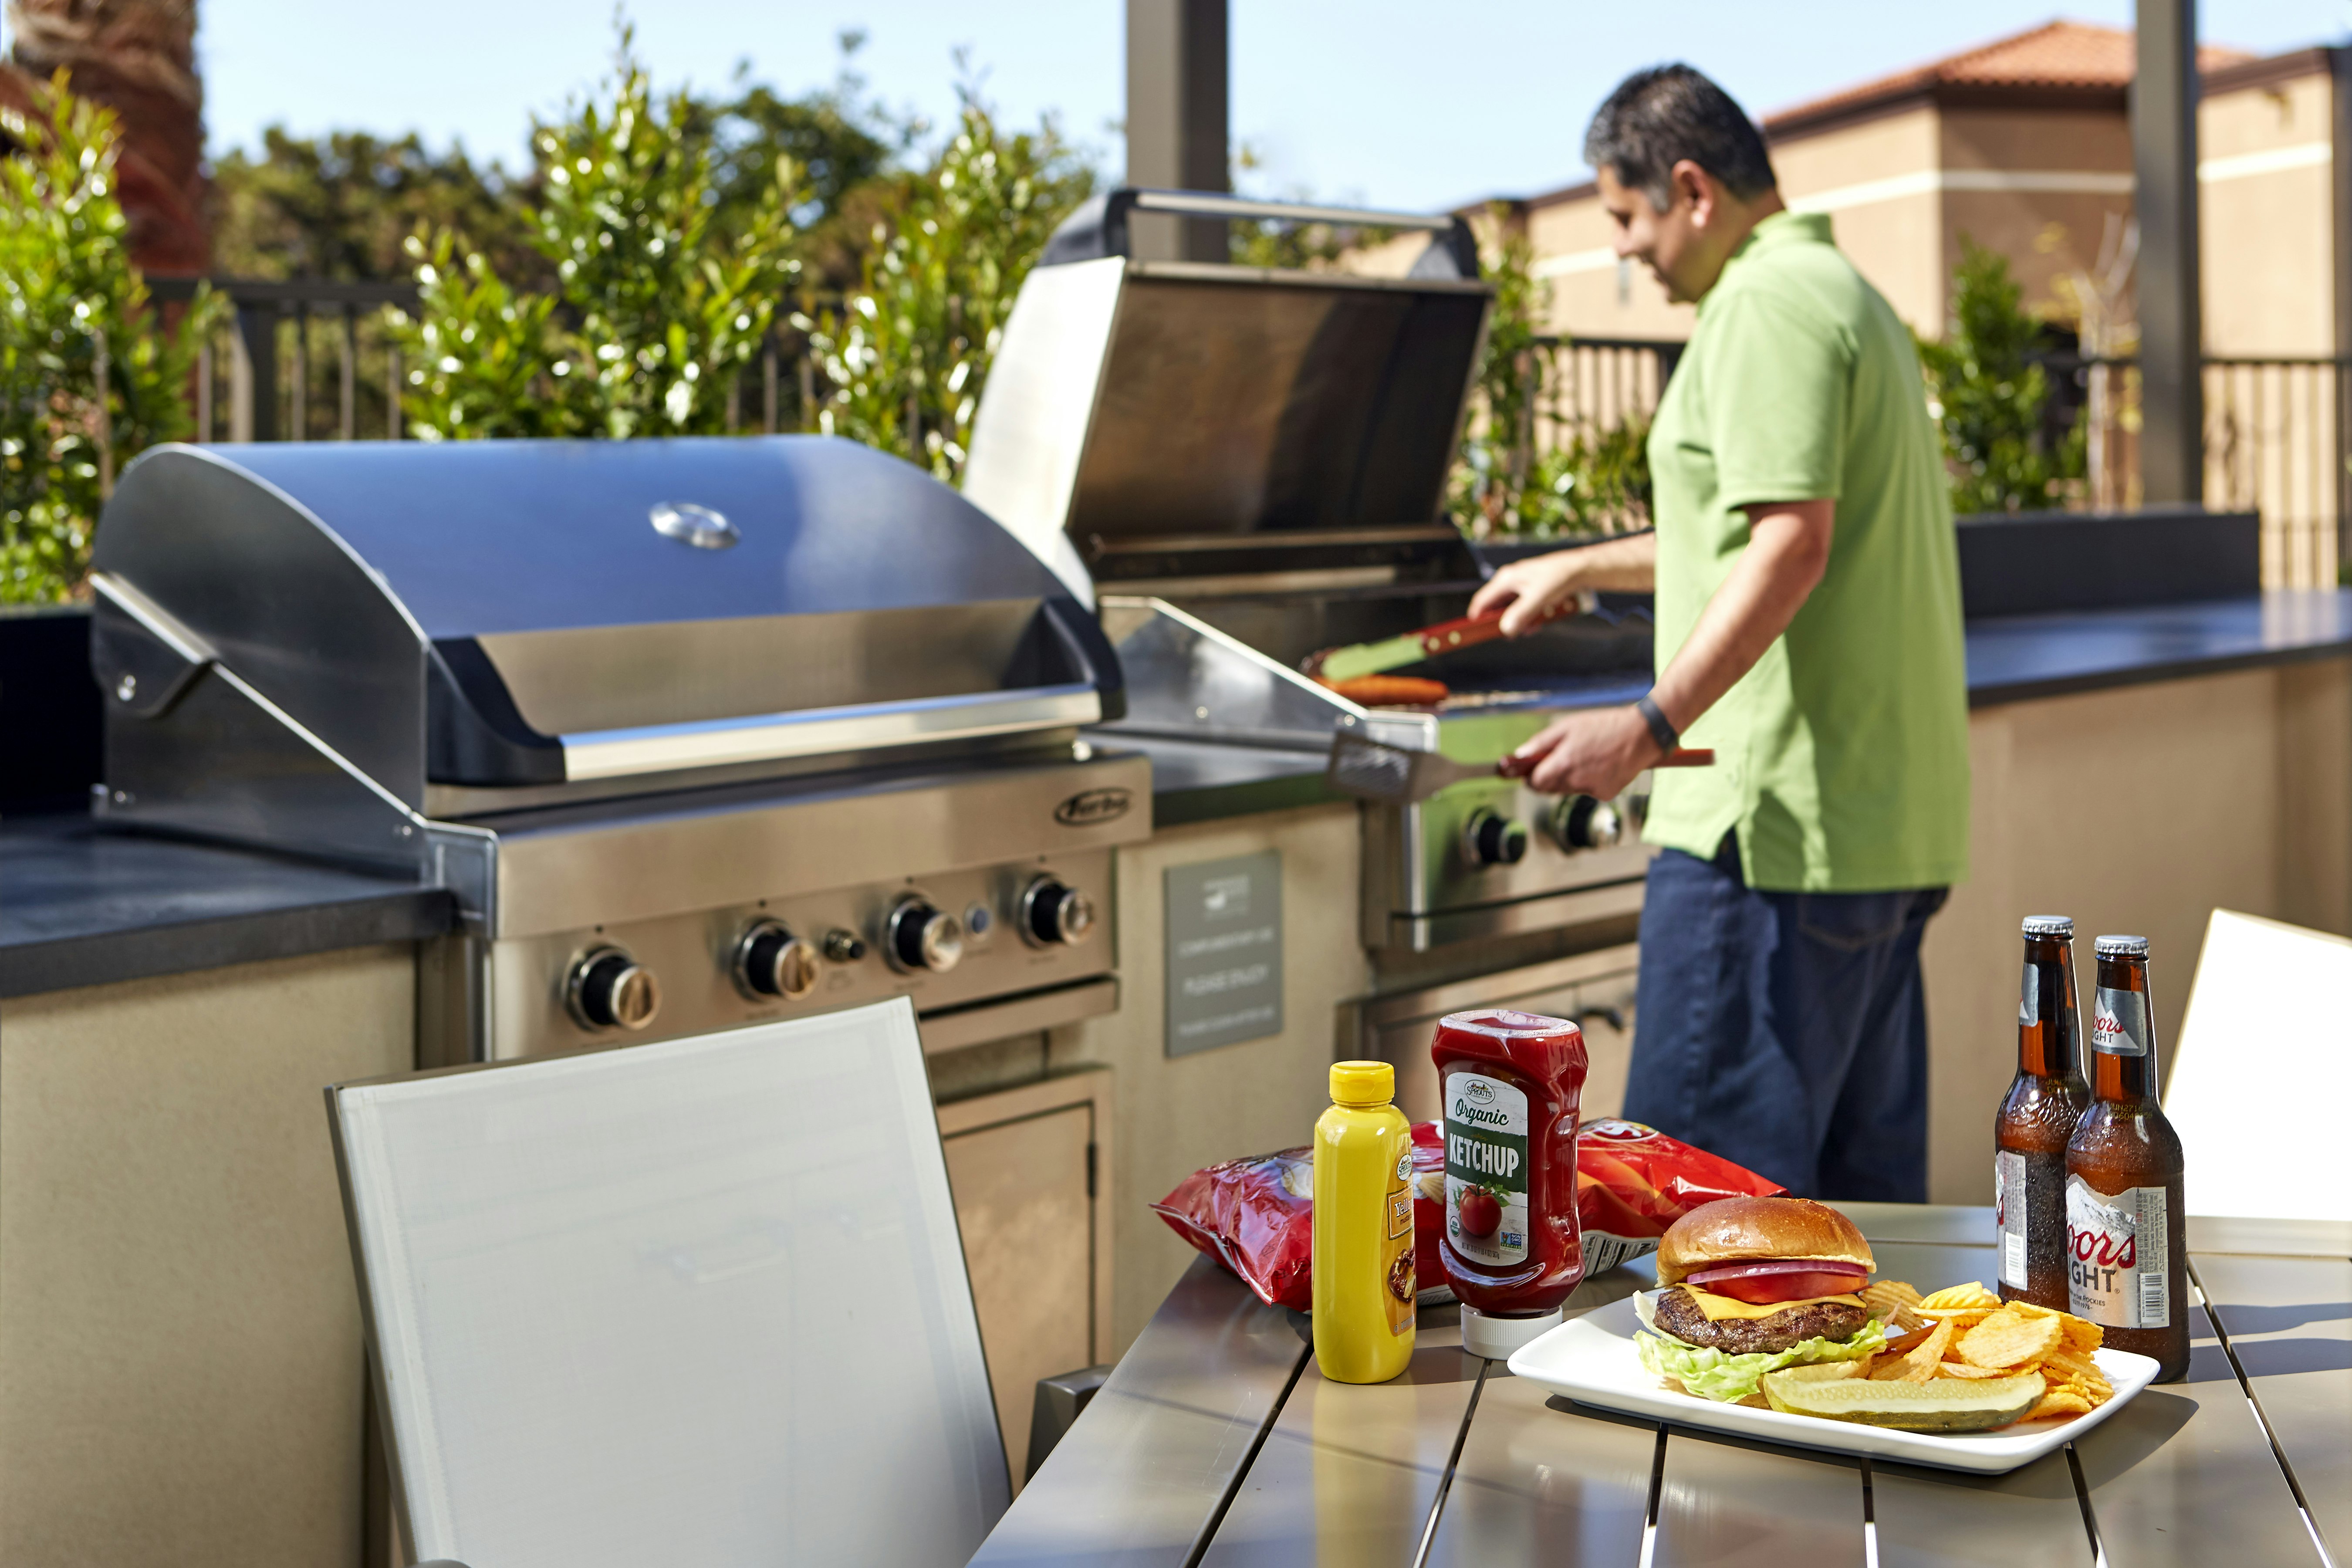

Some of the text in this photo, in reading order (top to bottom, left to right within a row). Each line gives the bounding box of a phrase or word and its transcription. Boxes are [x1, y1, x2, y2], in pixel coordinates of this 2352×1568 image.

[2092, 1015, 2125, 1034] oors
[2092, 1030, 2113, 1043] IGHT
[1467, 1086, 1493, 1098] SPROUTS
[1456, 1098, 1509, 1125] Organic
[1450, 1132, 1519, 1178] KETCHUP
[2068, 1224, 2136, 1269] oors
[2082, 1294, 2105, 1306] ROCKIES
